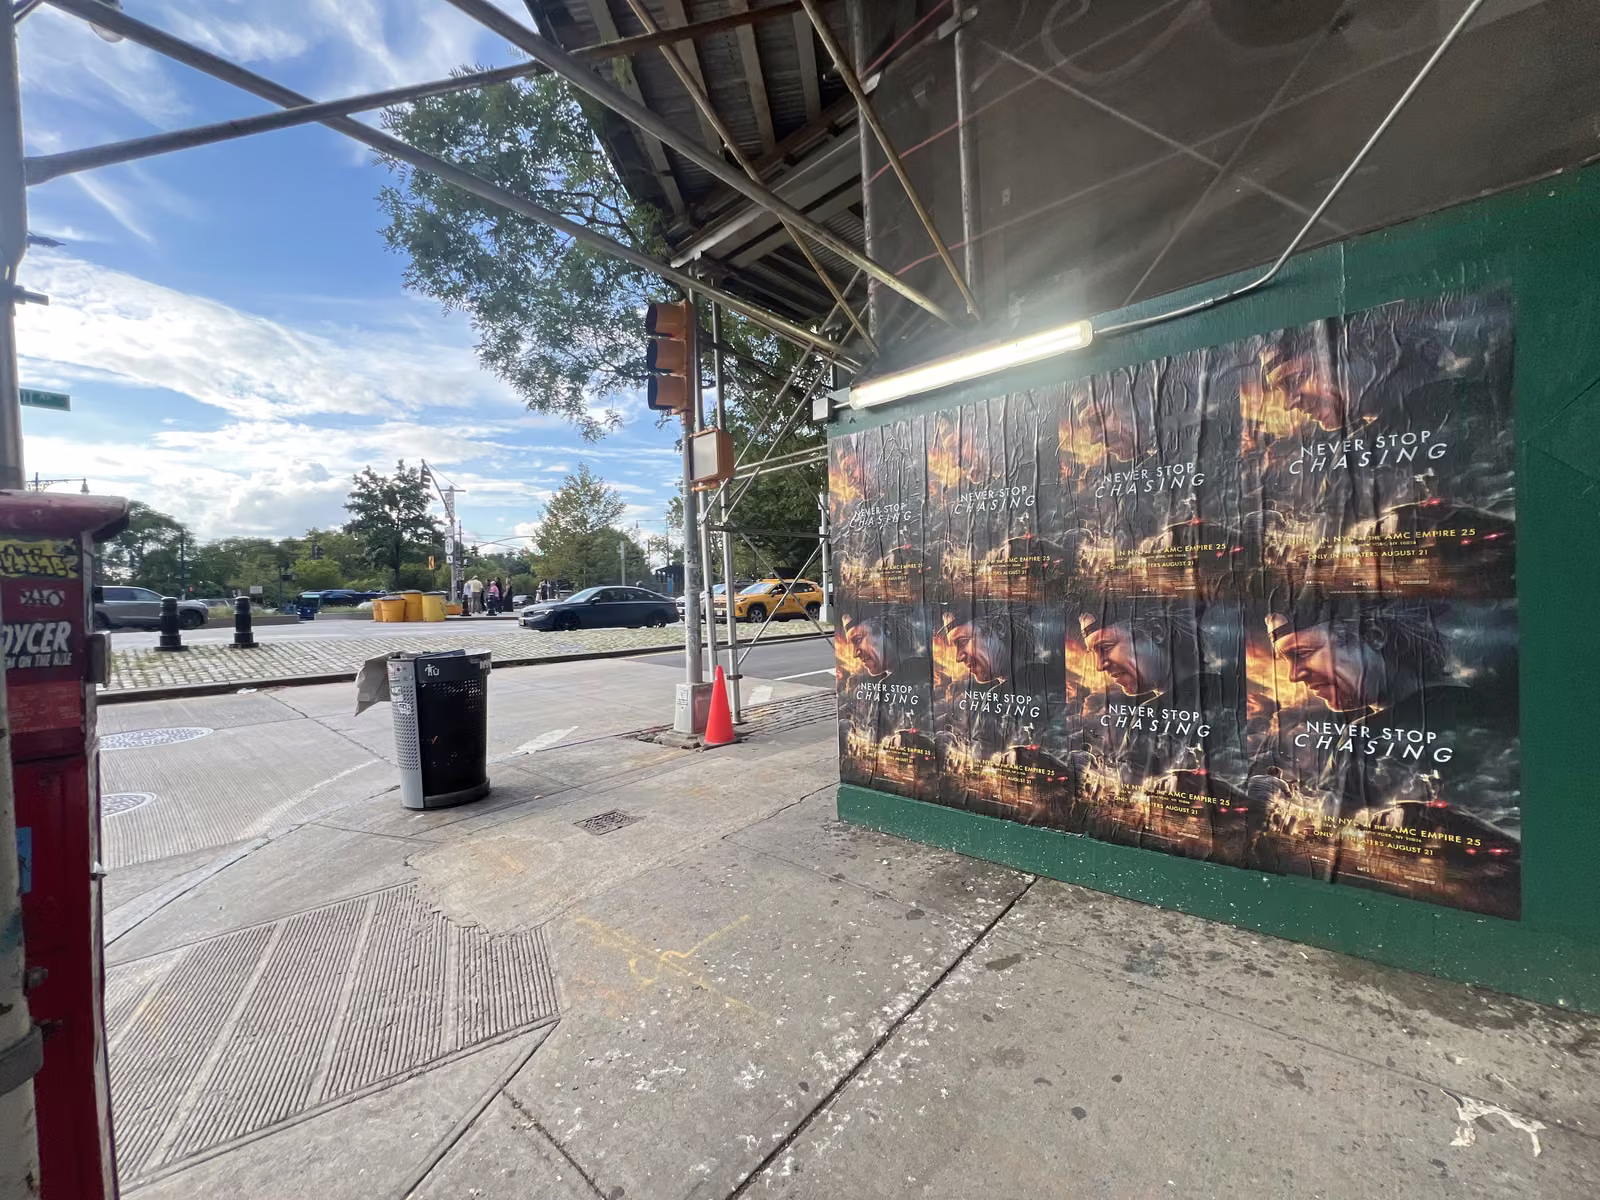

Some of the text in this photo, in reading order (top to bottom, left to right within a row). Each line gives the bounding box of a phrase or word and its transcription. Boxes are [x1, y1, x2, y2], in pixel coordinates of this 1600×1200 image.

[1300, 430, 1431, 458] NEVER STOP
[1289, 443, 1448, 475] CHASING
[1104, 463, 1194, 484] NEVER STOP
[961, 485, 1028, 502] NEVER STOP
[1095, 473, 1205, 499] CHASING
[855, 503, 907, 520] NEVER STOP
[954, 495, 1035, 515] CHASING
[850, 511, 912, 528] CHASING
[1385, 531, 1411, 540] AMC
[1416, 530, 1456, 539] EMPIRE
[1461, 528, 1476, 537] 25
[1185, 544, 1213, 552] EMPIRE
[860, 682, 913, 694] NEVER STOP
[856, 690, 919, 705] CHASING
[964, 690, 1032, 705] NEVER STOP
[959, 700, 1040, 718] CHASING
[1108, 704, 1200, 722] NEVER STOP
[1100, 715, 1212, 738] CHASING
[1306, 720, 1437, 744] NEVER STOP
[1294, 733, 1453, 763] CHASING
[1024, 766, 1046, 775] EMPIRE
[1168, 791, 1186, 799] AMC
[1189, 793, 1217, 804] EMPIRE
[1219, 799, 1231, 807] 25
[1165, 804, 1190, 813] AUGUST
[1324, 815, 1336, 823] IN
[1390, 826, 1417, 836] AMC
[1421, 830, 1462, 844] EMPIRE
[1466, 837, 1481, 847] 25
[1313, 830, 1334, 838] ONLY
[1387, 843, 1422, 854] AUGUST
